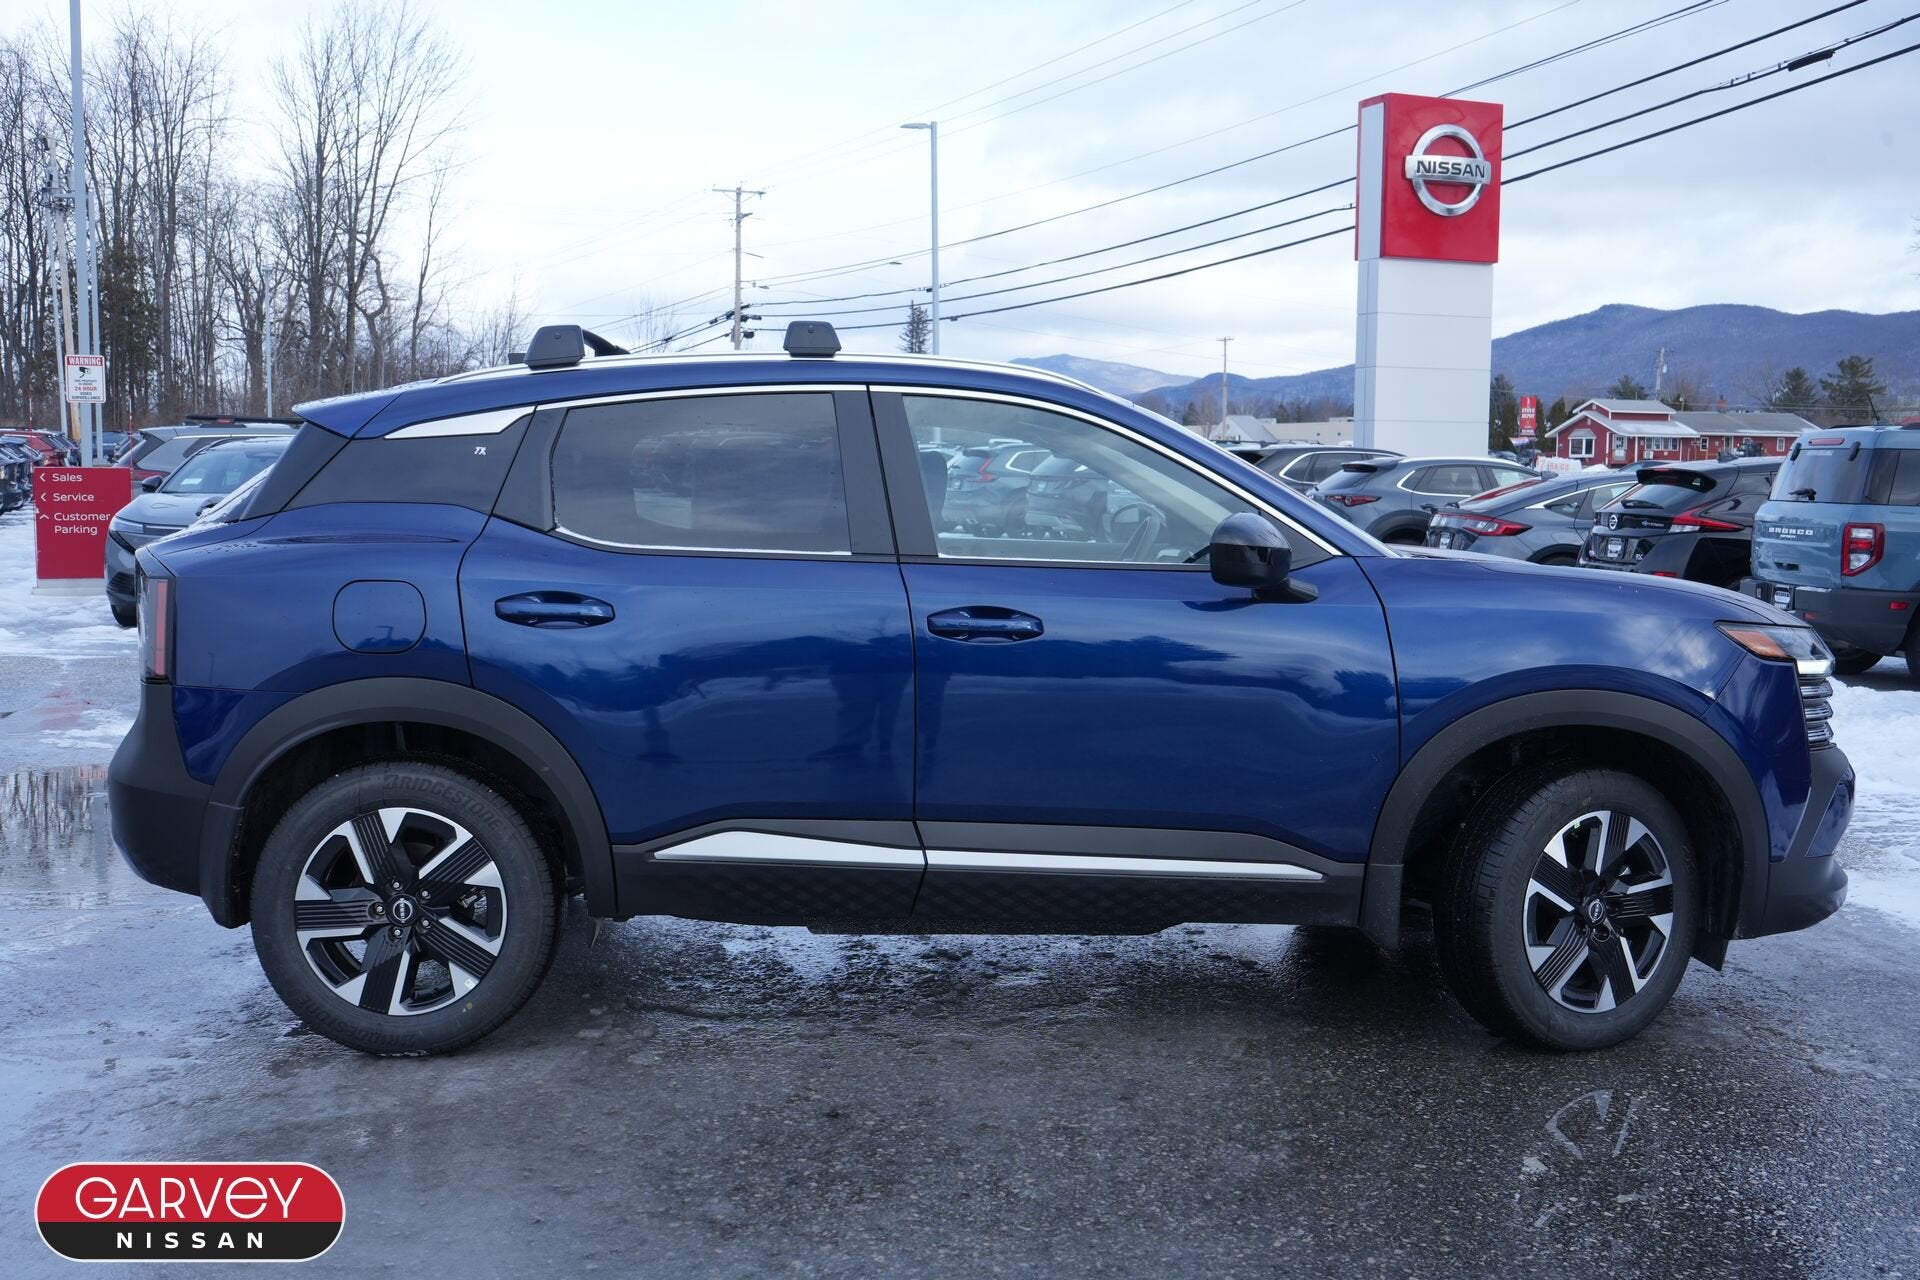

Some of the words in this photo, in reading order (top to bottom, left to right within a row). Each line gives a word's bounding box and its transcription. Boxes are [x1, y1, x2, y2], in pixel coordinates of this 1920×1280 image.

[1416, 160, 1485, 178] NISSAN
[69, 356, 102, 366] WARNING
[52, 473, 83, 482] Sales
[53, 492, 95, 502] Service
[53, 512, 111, 521] Customer
[54, 525, 98, 536] Parking
[1768, 527, 1814, 536] BRONCO
[383, 774, 501, 832] BRIDGESTONE
